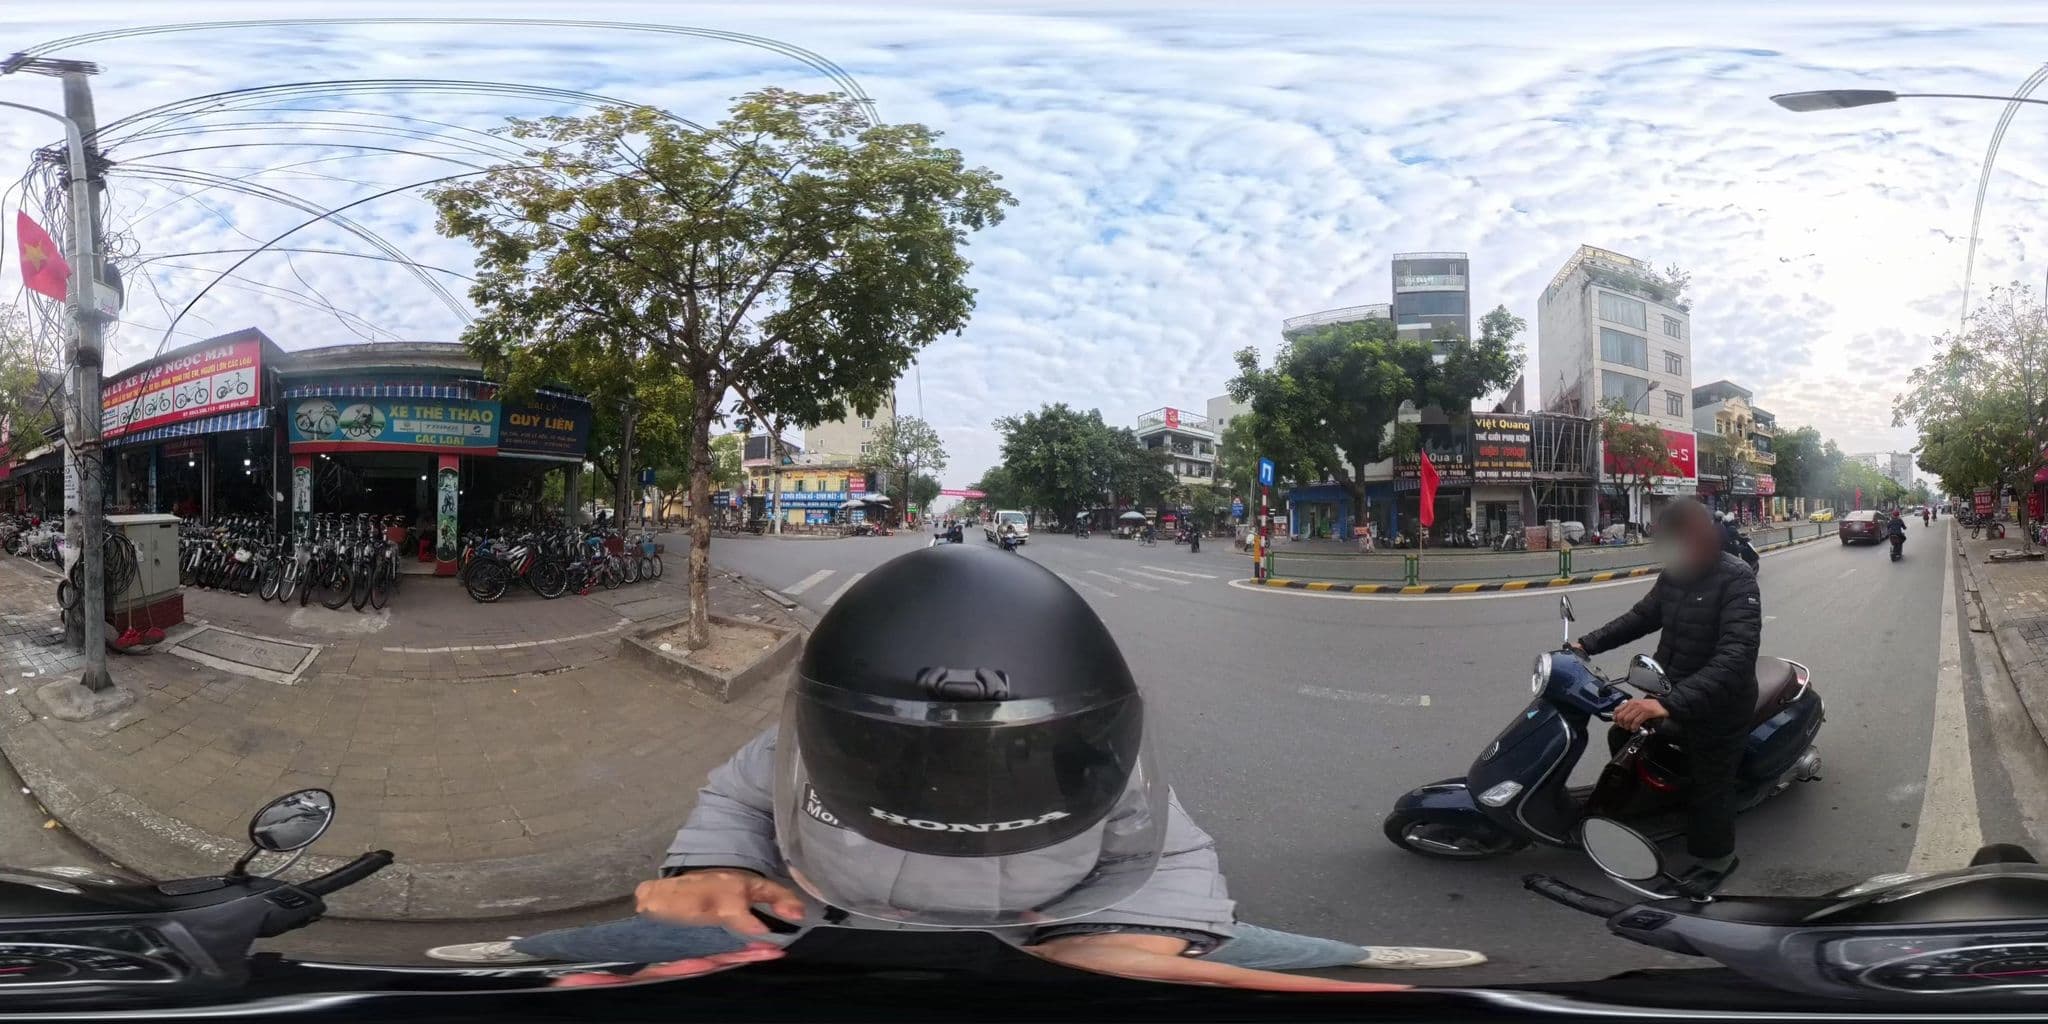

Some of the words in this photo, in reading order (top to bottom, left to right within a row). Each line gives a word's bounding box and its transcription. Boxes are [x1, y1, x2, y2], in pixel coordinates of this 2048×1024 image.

[125, 376, 138, 388] XE
[165, 353, 202, 374] NGỌC
[204, 344, 234, 362] MAI
[389, 405, 409, 418] XE
[448, 407, 494, 423] THAO
[544, 416, 574, 431] LIÊN
[1475, 418, 1497, 430] Việt
[1499, 419, 1530, 431] Quang
[869, 805, 1071, 832] HONDA
